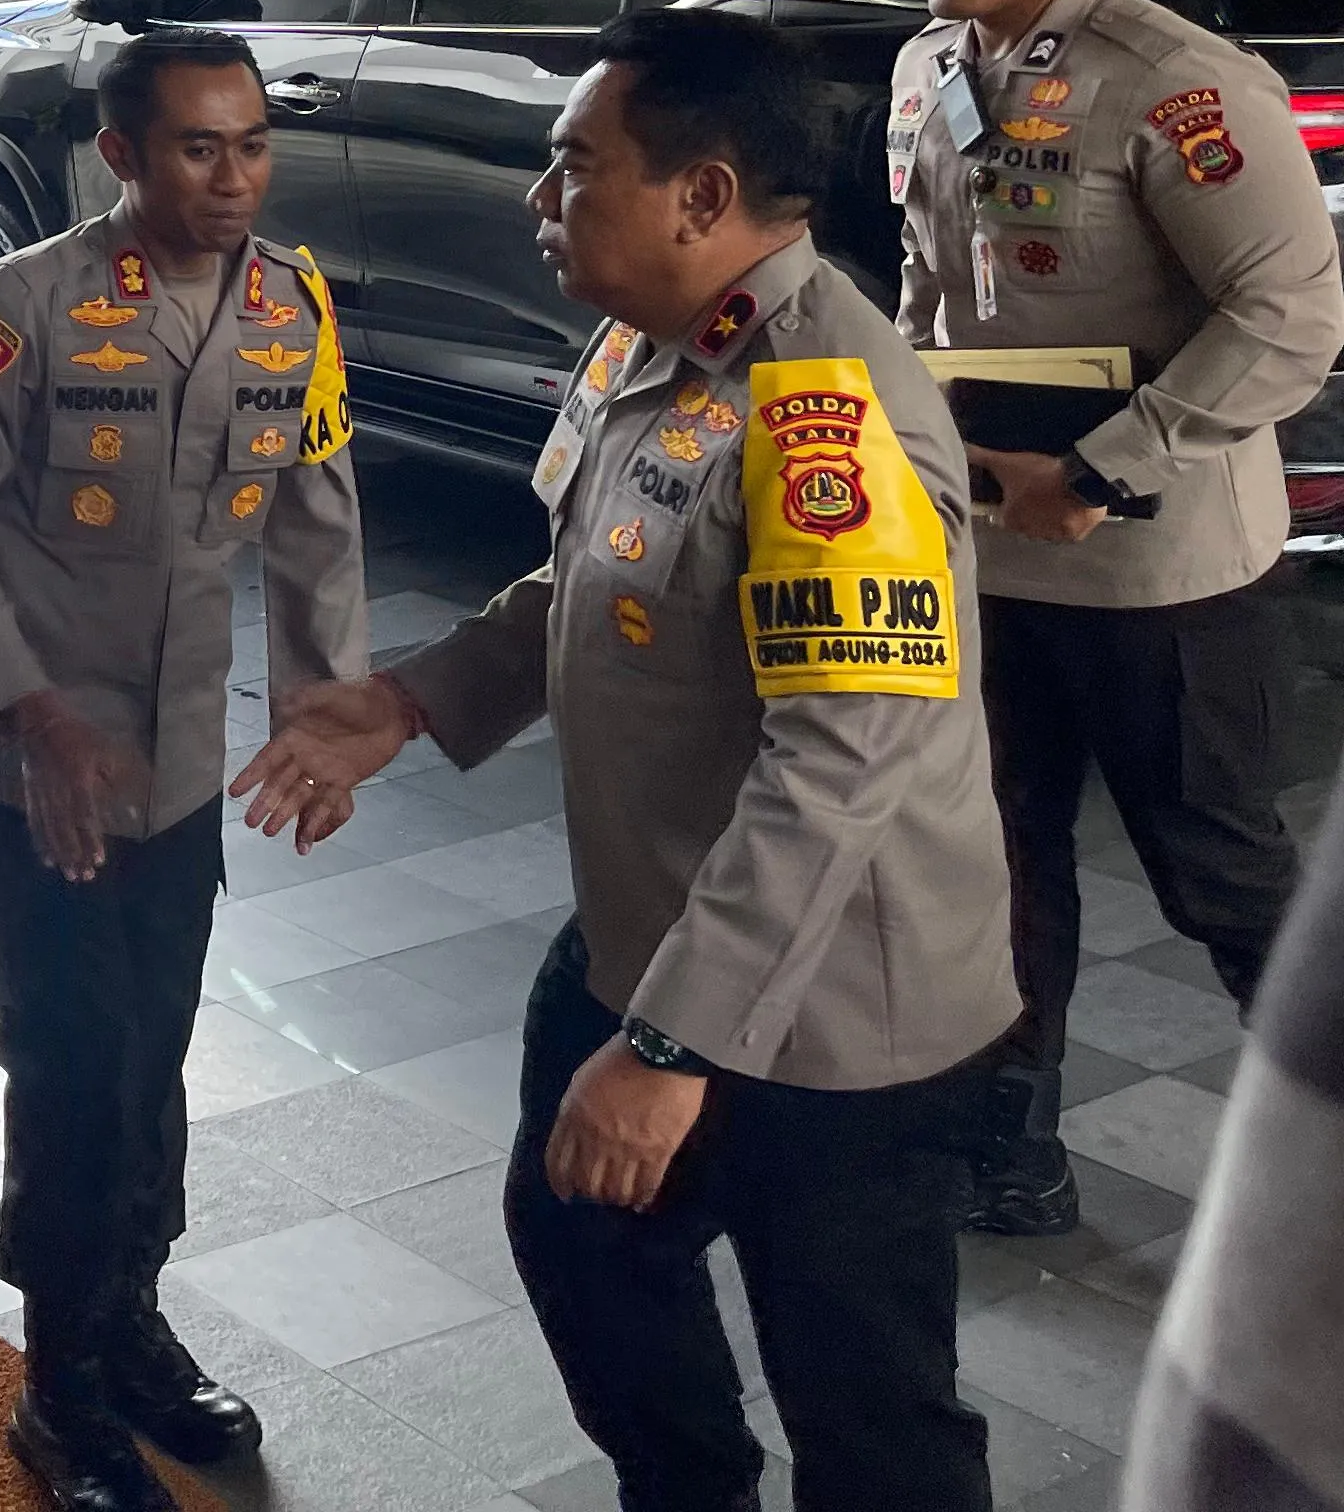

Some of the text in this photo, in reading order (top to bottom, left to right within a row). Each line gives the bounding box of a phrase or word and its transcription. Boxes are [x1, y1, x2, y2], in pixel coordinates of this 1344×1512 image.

[1156, 91, 1214, 121] POLDA
[986, 145, 1071, 172] POLRI
[771, 397, 857, 422] POLDA
[786, 429, 851, 444] BALI
[629, 456, 691, 514] POLRI
[751, 577, 844, 630] WAKIL
[818, 639, 948, 666] AGUNG-2024
